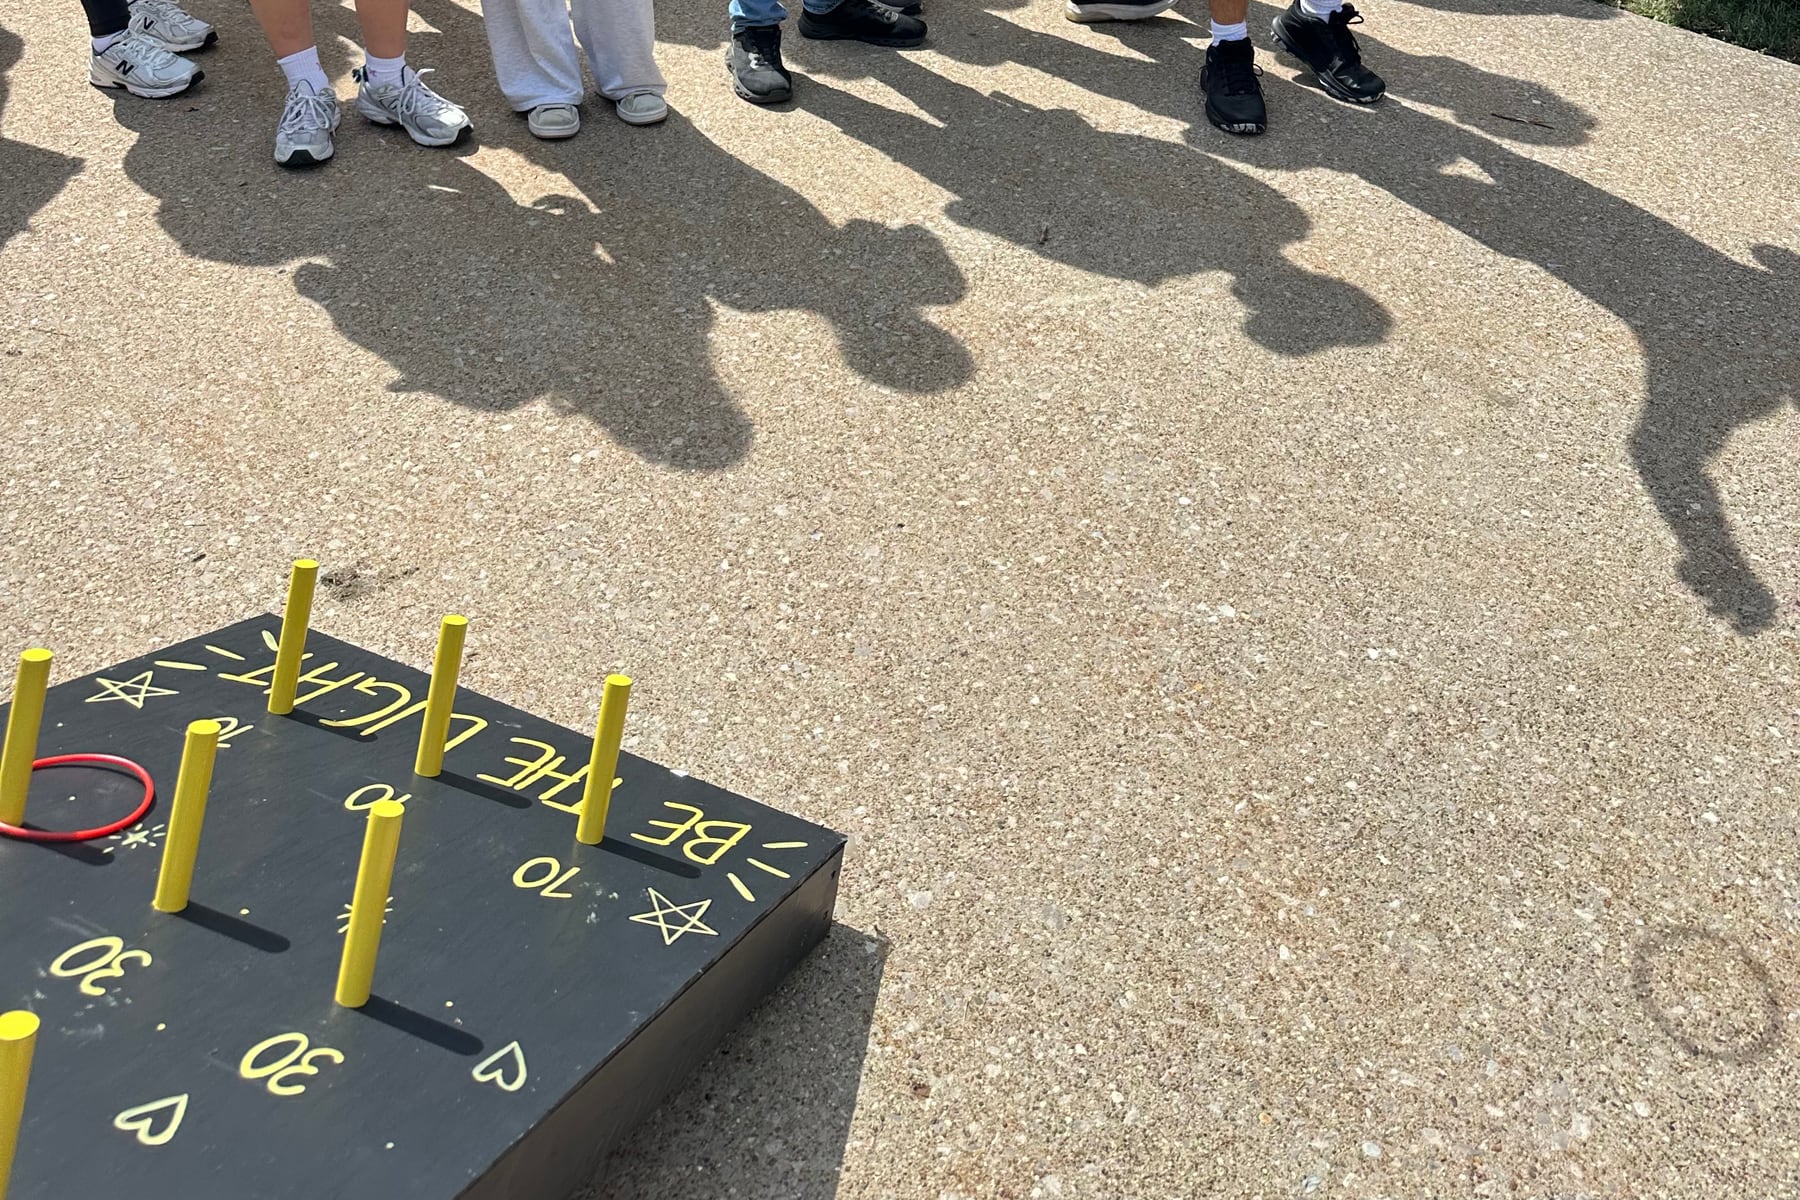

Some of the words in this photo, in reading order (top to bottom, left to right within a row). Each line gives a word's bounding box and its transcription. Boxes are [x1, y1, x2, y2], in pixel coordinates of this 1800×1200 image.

[630, 801, 752, 865] BE
[512, 856, 581, 899] 10
[49, 936, 153, 996] 30
[240, 1032, 345, 1096] 30
